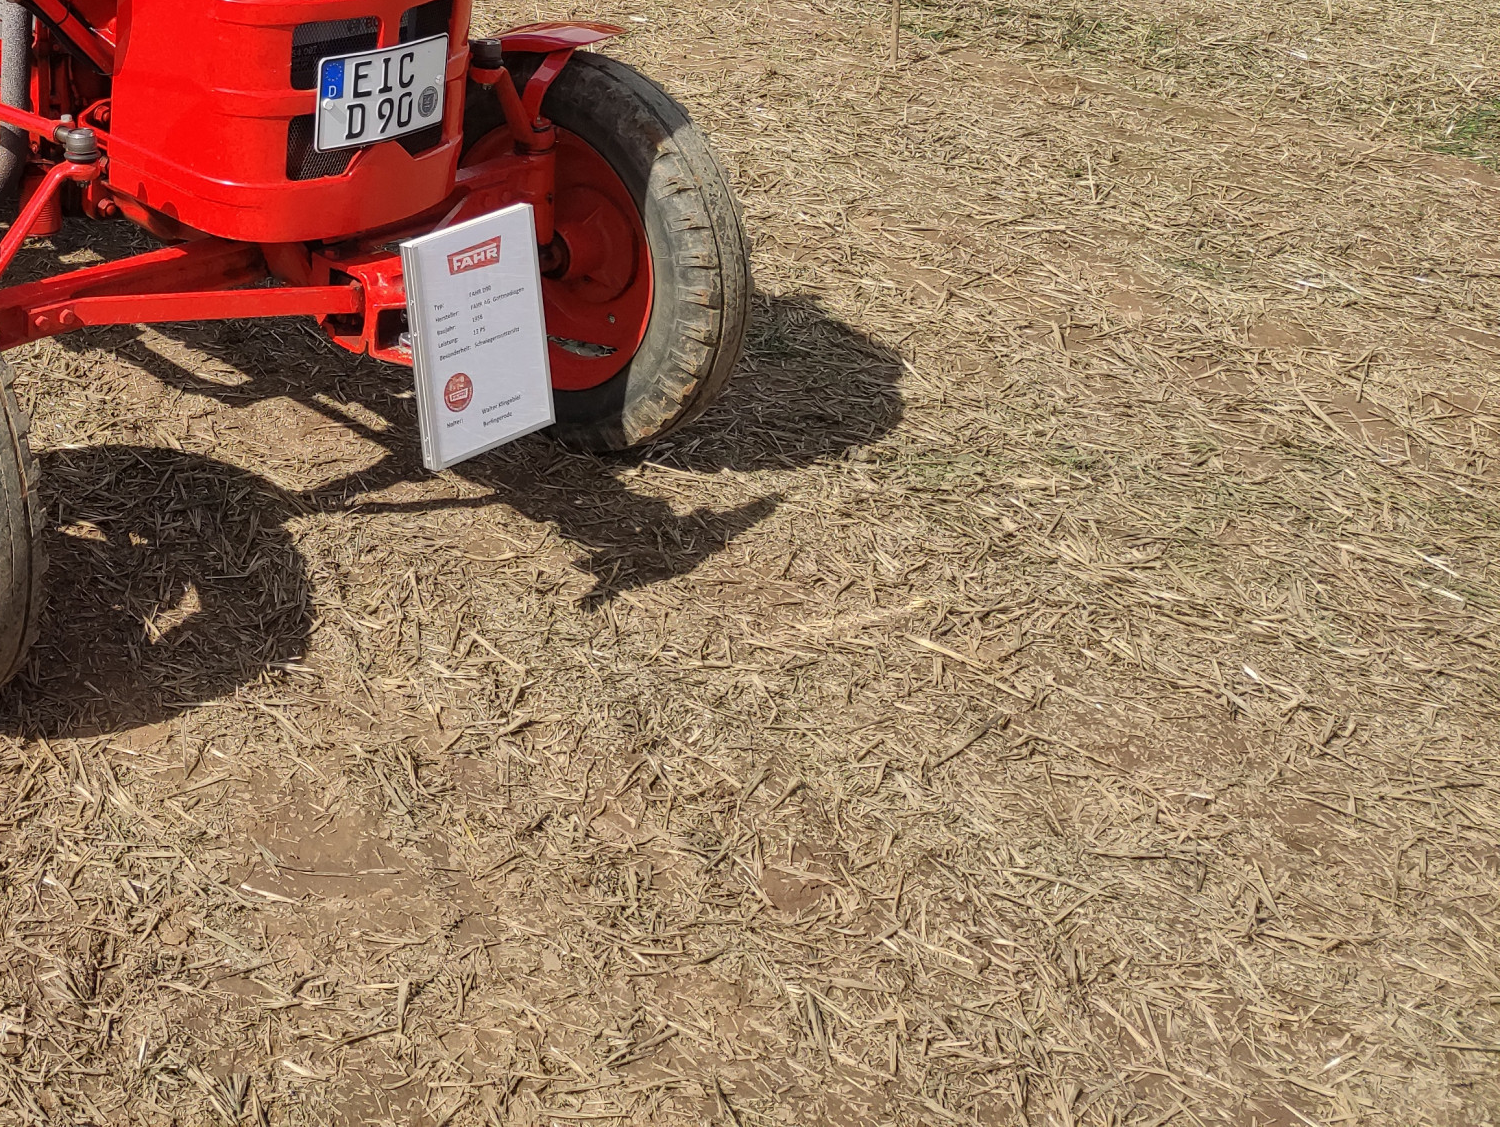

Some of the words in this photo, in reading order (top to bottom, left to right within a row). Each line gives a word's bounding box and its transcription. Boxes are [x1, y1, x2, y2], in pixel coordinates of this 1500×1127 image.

[328, 85, 337, 98] D
[352, 52, 415, 100] EIC
[345, 103, 366, 141] D
[376, 91, 414, 134] 90
[453, 242, 499, 272] FAHR
